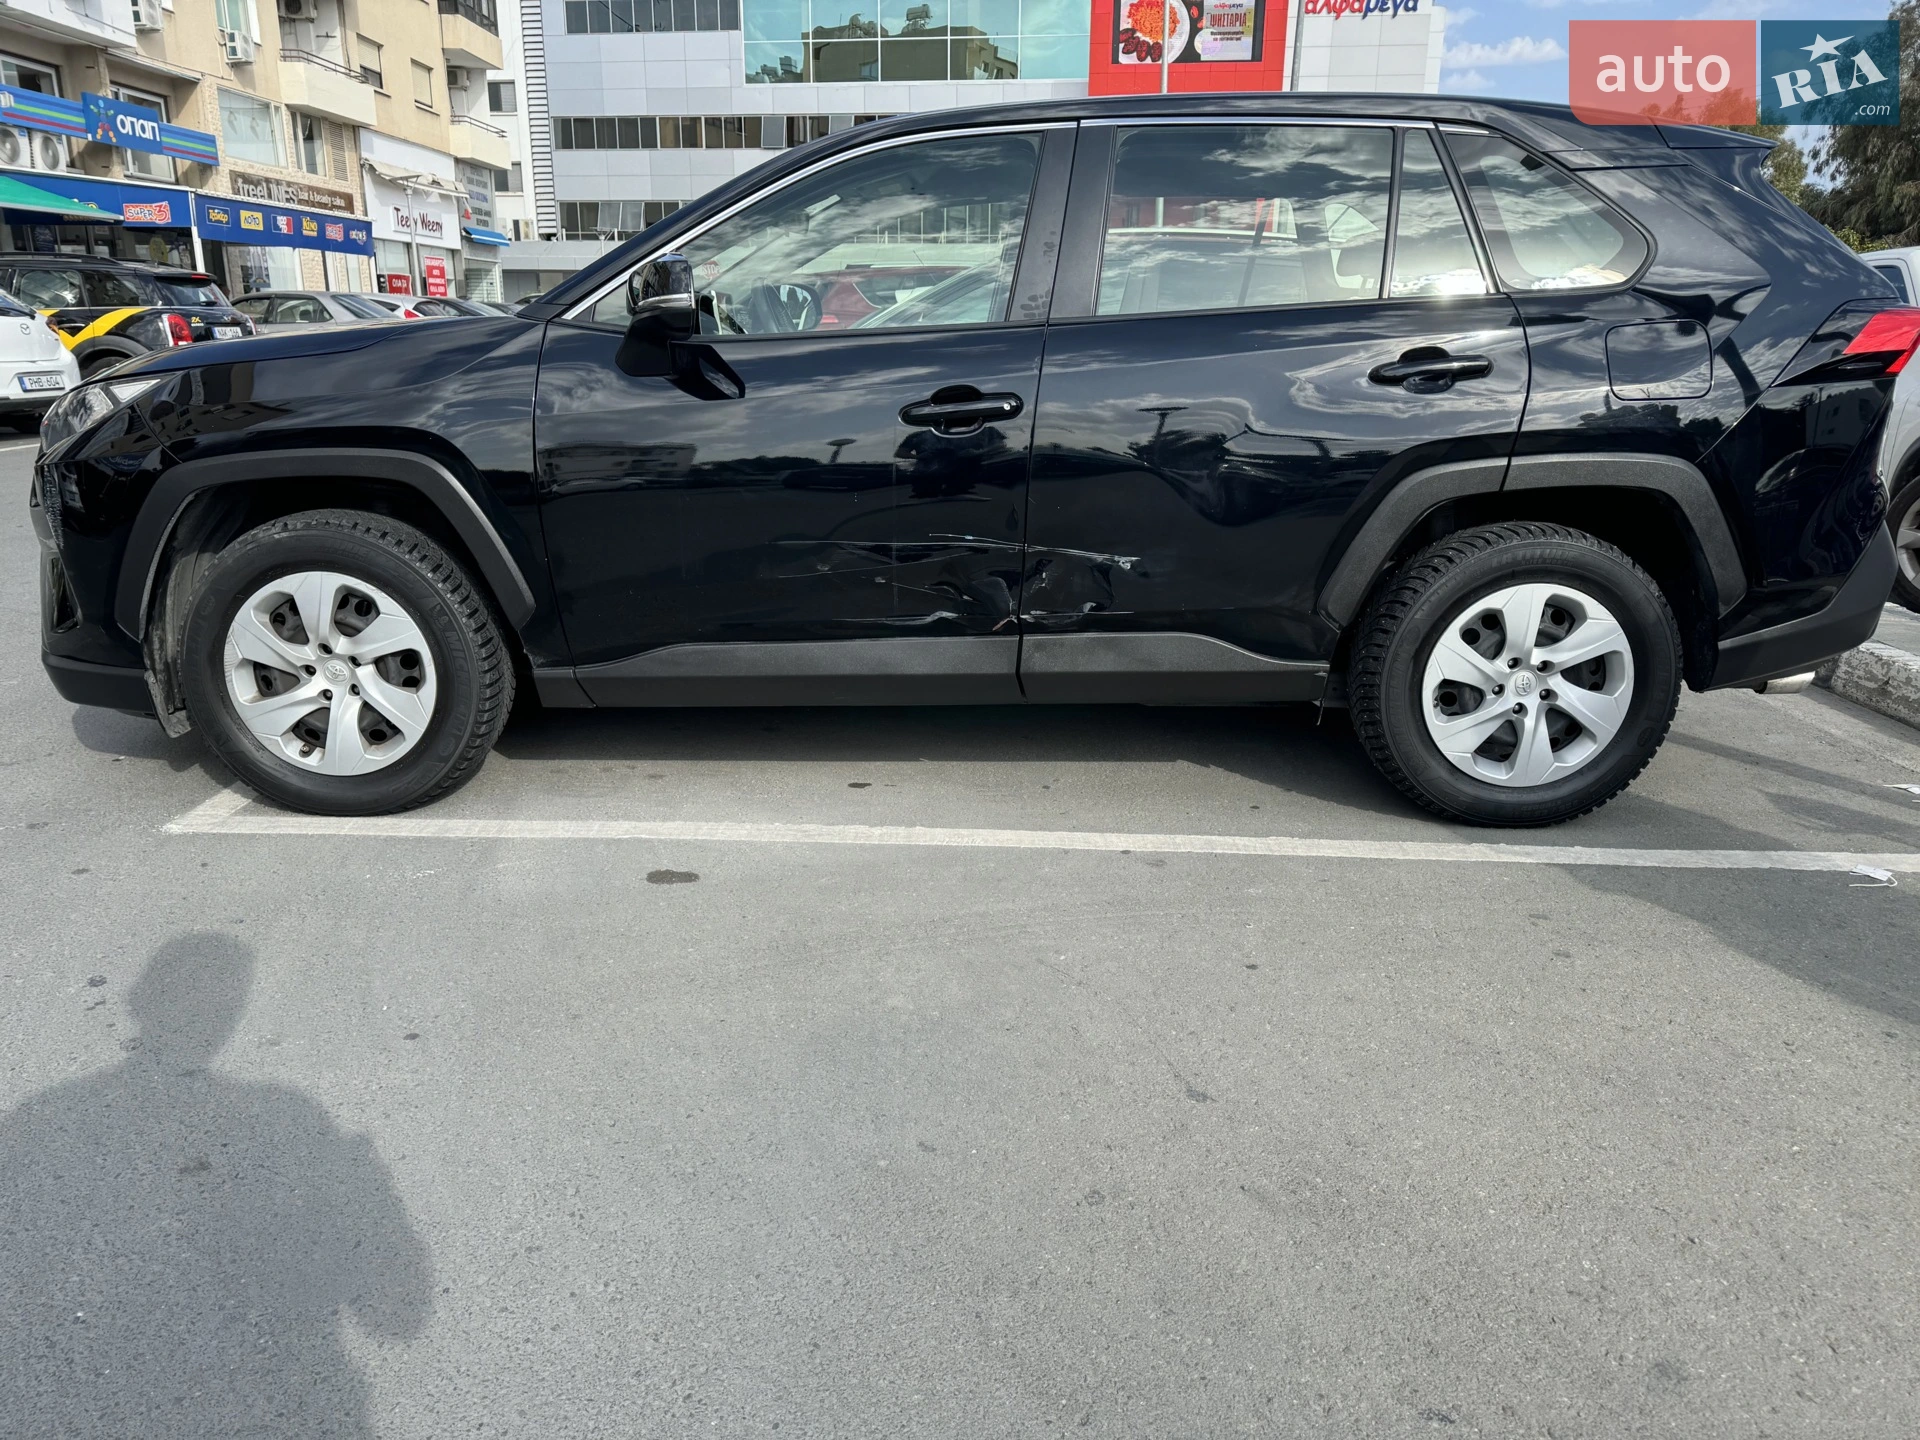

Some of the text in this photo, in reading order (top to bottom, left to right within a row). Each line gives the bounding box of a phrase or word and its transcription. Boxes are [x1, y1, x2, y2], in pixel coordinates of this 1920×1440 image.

[153, 201, 169, 223] 3
[394, 206, 418, 233] Teey
[418, 211, 443, 237] Weeny
[28, 376, 60, 388] PHB 604
